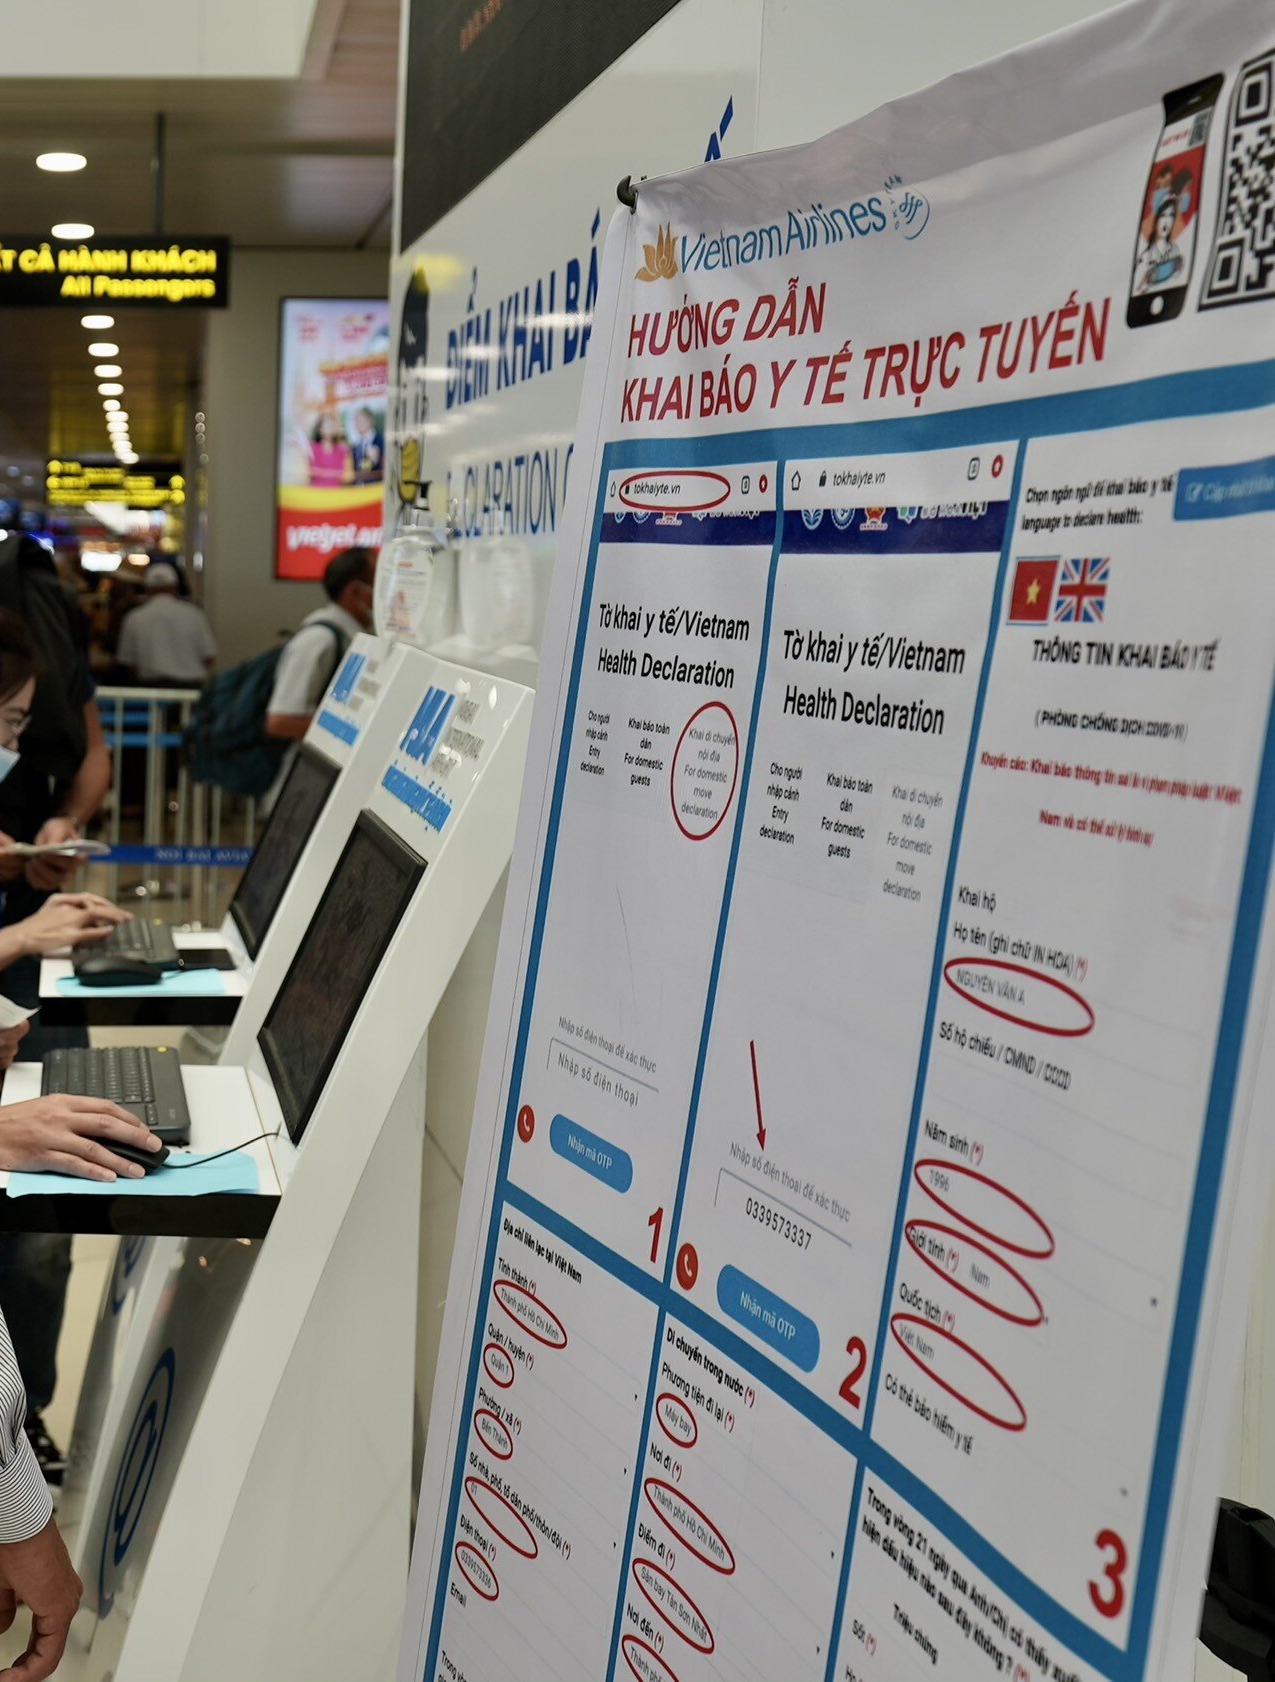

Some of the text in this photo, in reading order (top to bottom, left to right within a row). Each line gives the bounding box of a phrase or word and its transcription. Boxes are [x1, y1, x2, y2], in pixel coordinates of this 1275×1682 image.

[60, 275, 216, 302] All Passengers
[628, 276, 826, 359] HƯỚNG DẪN
[497, 270, 556, 391] KHAI
[621, 290, 1111, 423] KHAI BÁO Y TẾ TRỰC TUYẾN
[633, 483, 681, 497] tokhaiyte.vn
[833, 471, 886, 489] tokhaiyte.vn
[599, 603, 750, 641] Tờ khai y tế/Vietnam
[784, 629, 966, 674] Tờ khai y tế/Vietnam
[1117, 642, 1159, 669] KHAI
[597, 647, 734, 688] Health Declaration
[784, 684, 945, 735] Health Declaration
[628, 717, 641, 729] Khai
[643, 721, 654, 732] báo
[589, 745, 600, 759] Entry
[624, 752, 663, 770] For domestic
[580, 760, 604, 776] declaration
[630, 774, 651, 786] guests
[684, 765, 727, 783] For domestic
[770, 763, 783, 776] Cho
[693, 786, 712, 799] move
[827, 773, 842, 788] Khai
[681, 802, 718, 820] declaration
[772, 806, 789, 823] Entry
[760, 824, 795, 844] declaration
[821, 817, 865, 839] For domestic
[828, 843, 851, 858] guests
[887, 832, 932, 856] For domestic
[895, 860, 916, 875] move
[883, 880, 921, 902] declaration
[959, 886, 981, 907] Khai
[954, 922, 969, 942] Họ
[625, 1050, 638, 1064] xác
[558, 1052, 579, 1076] Nhập
[615, 1082, 639, 1107] thoại
[567, 1134, 585, 1158] Nhận
[597, 1152, 613, 1170] OTP
[949, 1134, 969, 1157] sinh
[648, 1206, 664, 1264] 1
[746, 1197, 811, 1250] 0339573337
[900, 1283, 922, 1310] Quốc
[740, 1290, 762, 1317] Nhận
[777, 1317, 796, 1340] OTP
[661, 1362, 690, 1398] Phương
[704, 1355, 723, 1383] trong
[724, 1373, 744, 1396] nước
[838, 1336, 867, 1409] 2
[679, 1418, 691, 1437] bay
[650, 1442, 671, 1471] Nơi đi
[708, 1539, 725, 1560] Minh
[916, 1531, 927, 1555] 21
[1088, 1529, 1128, 1619] 3
[450, 1582, 467, 1608] Email
[654, 1579, 665, 1600] bay
[678, 1604, 691, 1623] Sơn
[627, 1602, 654, 1640] Nơi đến
